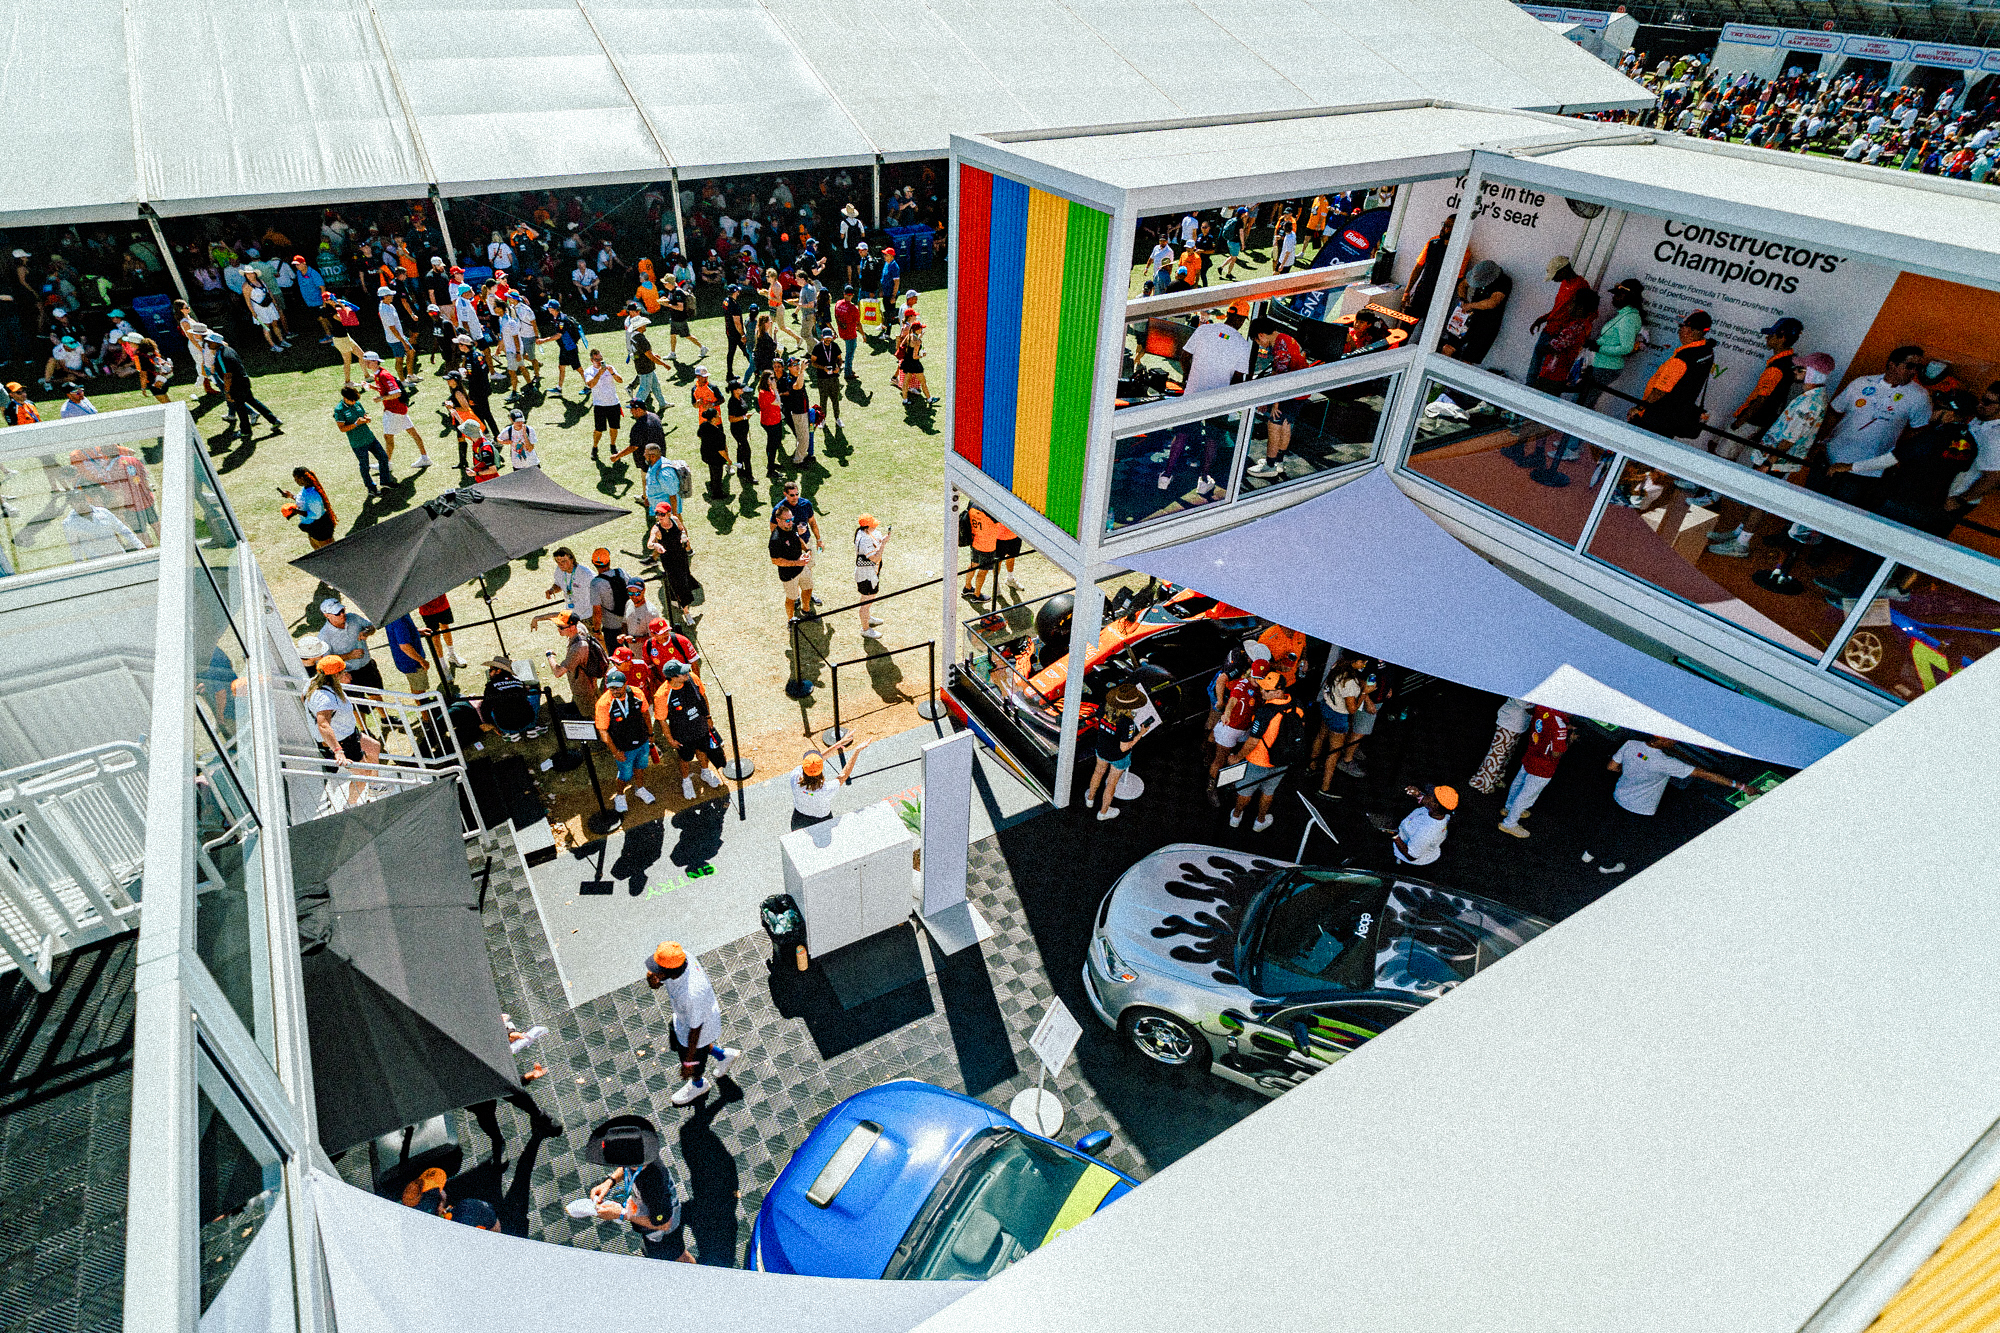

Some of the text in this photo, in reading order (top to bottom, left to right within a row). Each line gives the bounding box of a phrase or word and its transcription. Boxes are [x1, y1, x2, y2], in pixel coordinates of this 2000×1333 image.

[1501, 184, 1516, 202] in
[1519, 188, 1546, 208] the
[1503, 208, 1539, 229] seat
[1653, 240, 1800, 295] Champions
[1645, 273, 1657, 283] The
[1657, 277, 1687, 291] McLaren
[1687, 285, 1716, 299] Formula
[1721, 293, 1741, 305] Team
[1741, 300, 1769, 313] pushes
[1770, 306, 1784, 317] the
[1720, 320, 1733, 330] the
[1732, 344, 1745, 353] the
[645, 863, 719, 901] ENTRY
[1354, 912, 1374, 939] ebay
